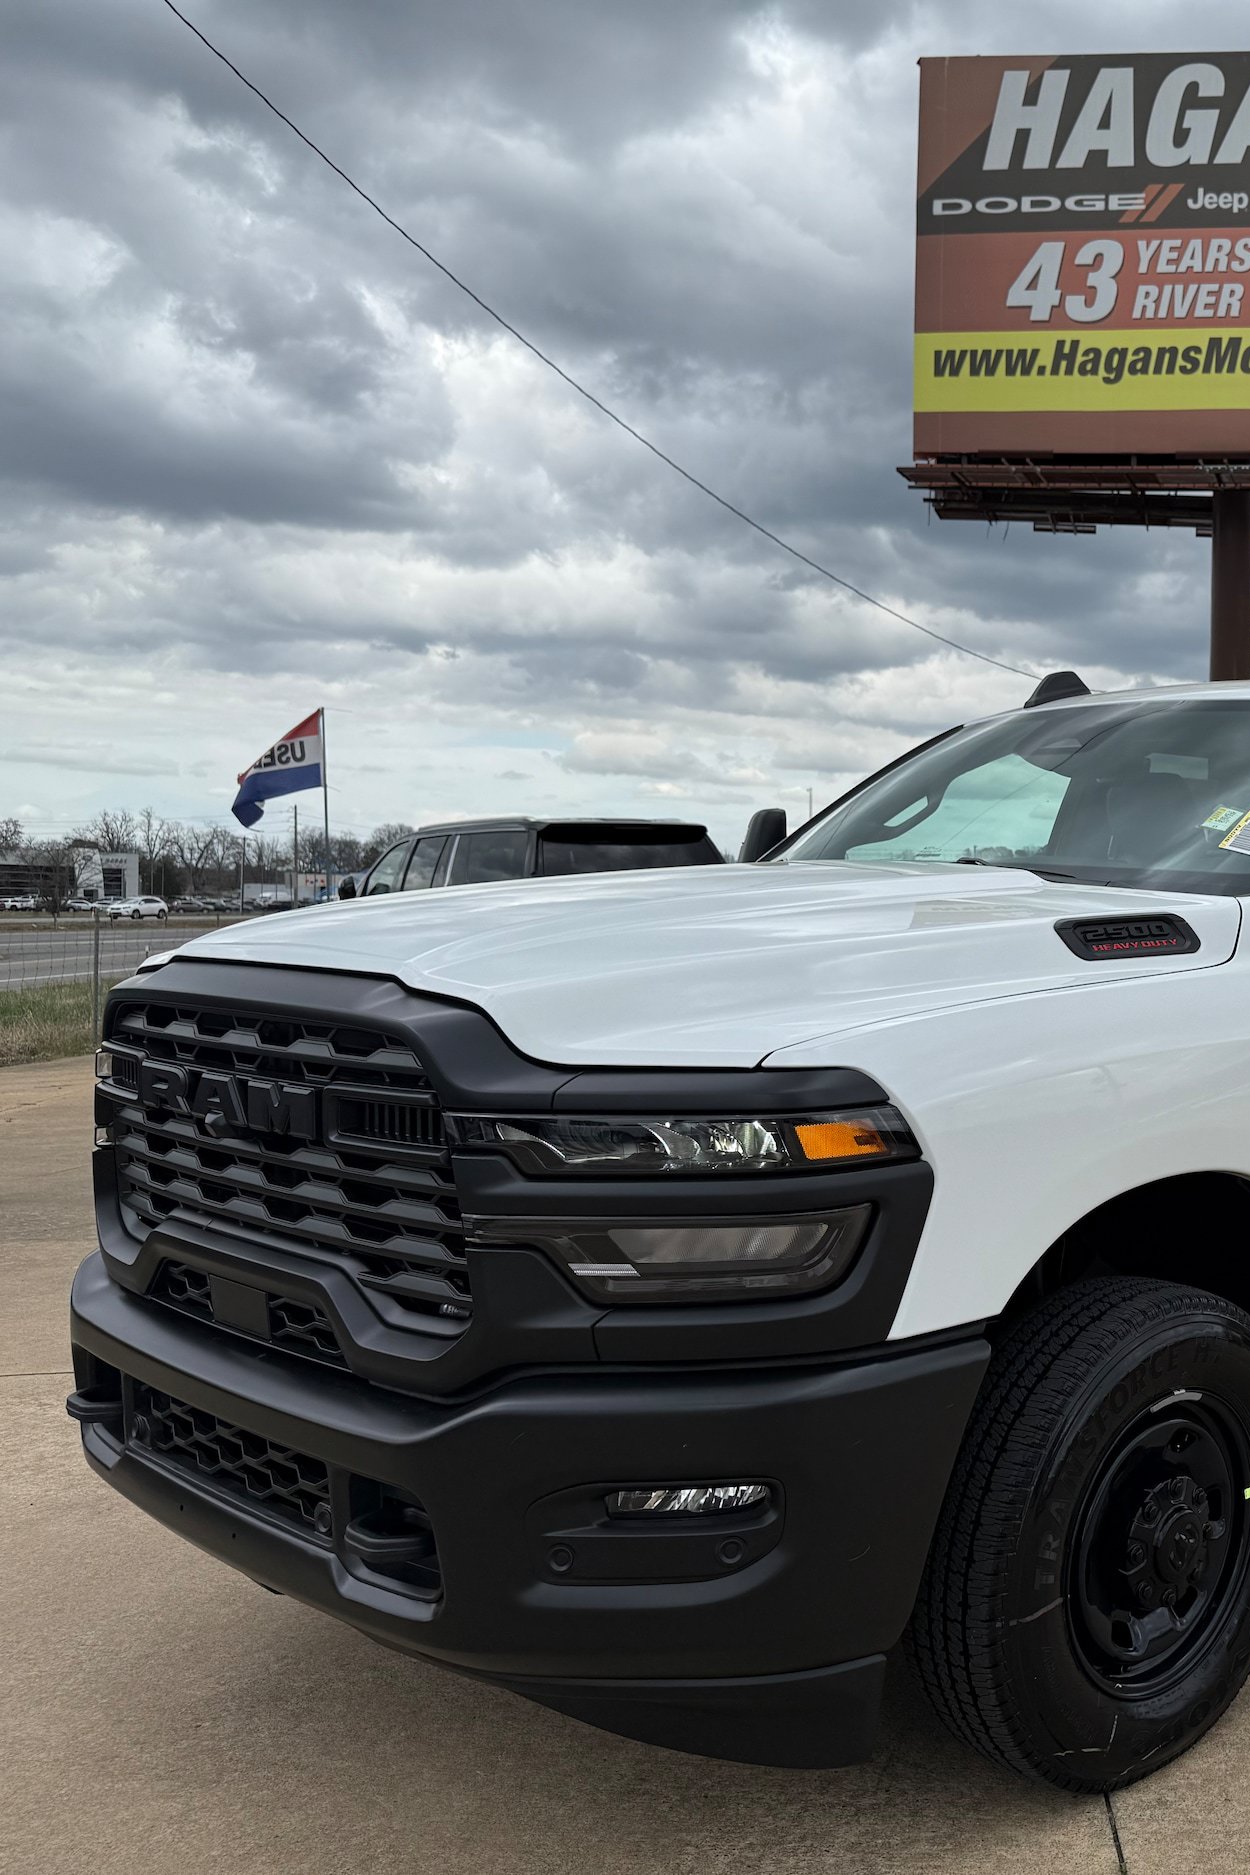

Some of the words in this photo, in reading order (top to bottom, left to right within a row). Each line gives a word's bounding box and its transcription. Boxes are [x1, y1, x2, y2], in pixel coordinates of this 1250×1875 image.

[932, 192, 1147, 215] DODGE
[1187, 187, 1249, 213] Jeep
[1006, 239, 1125, 323] 43
[1132, 282, 1245, 319] RIVER
[1081, 921, 1170, 942] 2500
[1092, 941, 1139, 952] HEAVY
[1140, 938, 1178, 949] DUTY
[140, 1059, 317, 1141] RAM
